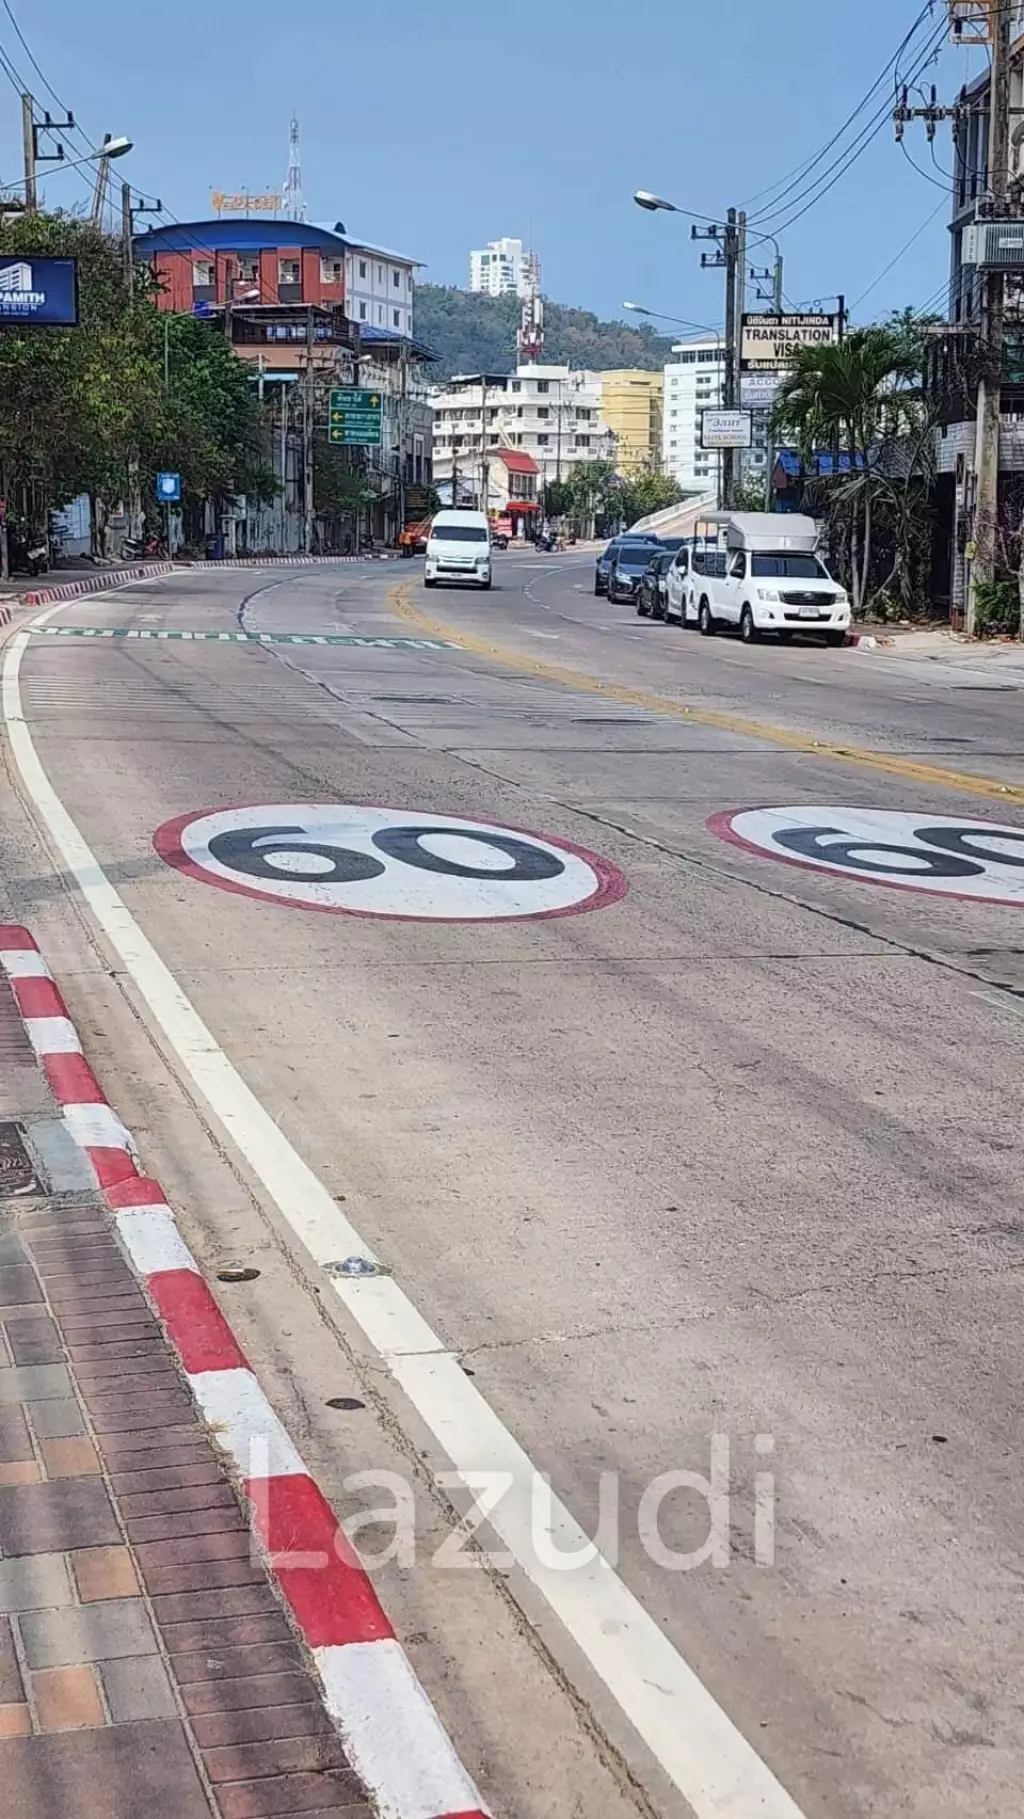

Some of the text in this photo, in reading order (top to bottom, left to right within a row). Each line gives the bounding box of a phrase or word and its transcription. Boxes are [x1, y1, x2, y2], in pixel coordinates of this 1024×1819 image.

[781, 315, 829, 325] NITIJINDA
[745, 328, 830, 341] TRANSLATION
[208, 825, 566, 883] 60
